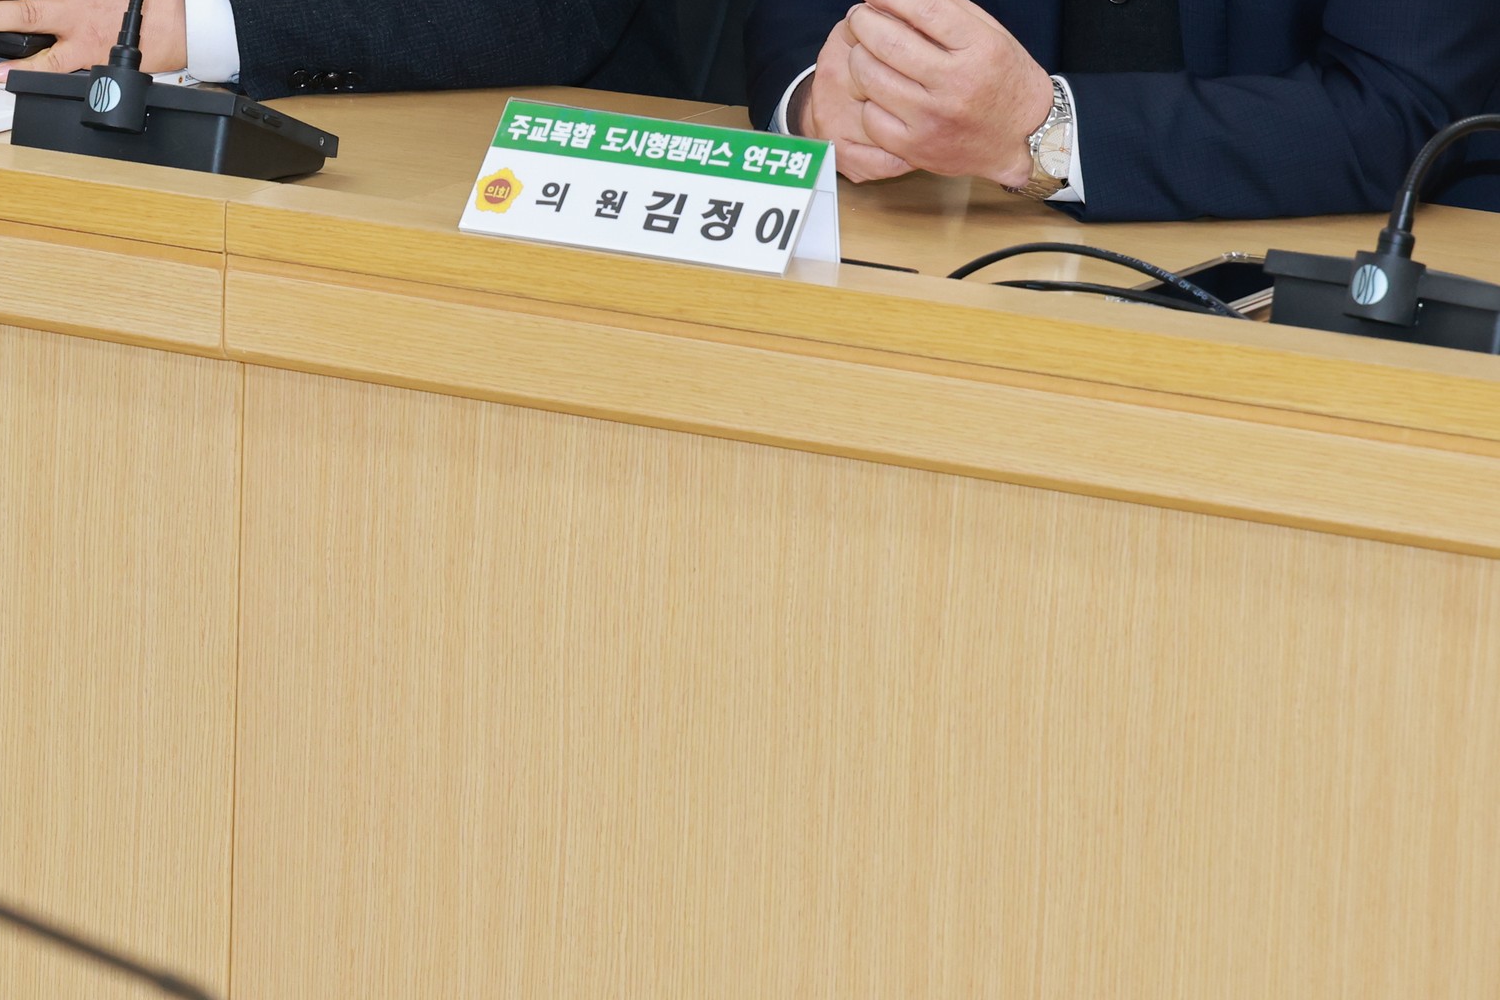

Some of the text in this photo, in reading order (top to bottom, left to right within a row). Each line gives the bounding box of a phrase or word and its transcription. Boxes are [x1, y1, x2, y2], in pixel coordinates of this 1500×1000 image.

[507, 114, 813, 179] 주교복합 도시형캠퍼스 연구회
[485, 185, 510, 199] 의회
[642, 191, 801, 251] 김정이
